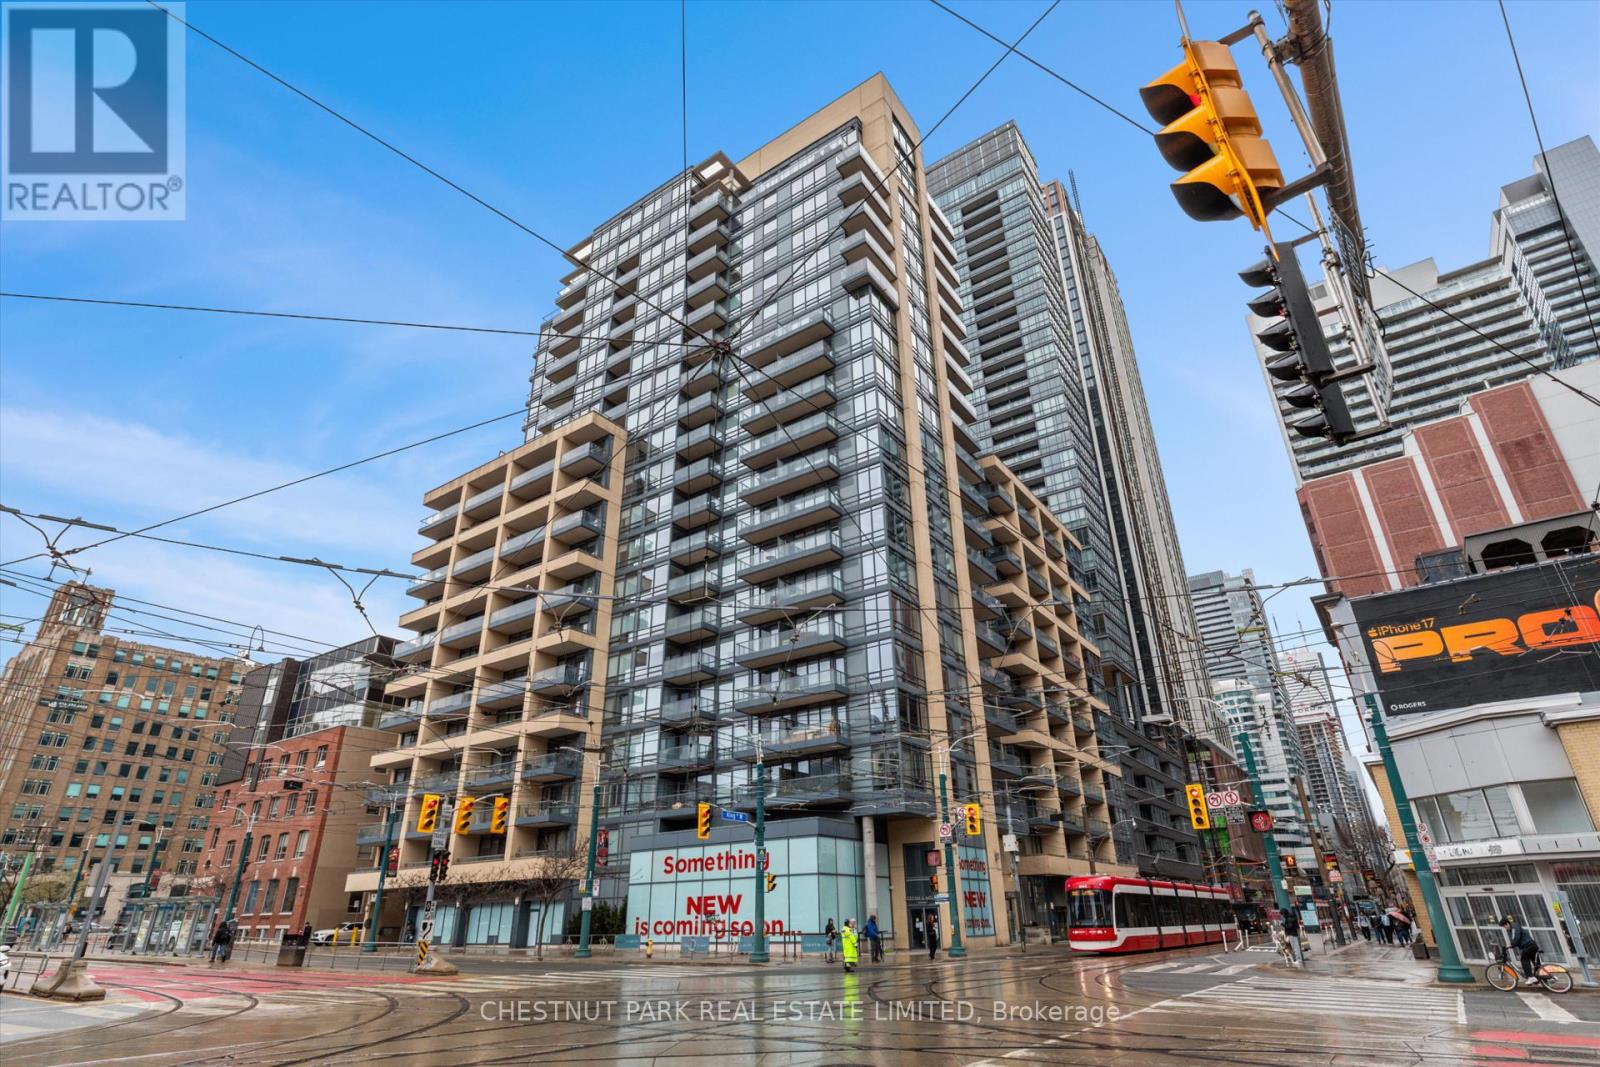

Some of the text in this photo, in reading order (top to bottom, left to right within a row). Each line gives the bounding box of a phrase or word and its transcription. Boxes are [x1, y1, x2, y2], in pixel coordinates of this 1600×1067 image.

[1378, 617, 1435, 636] iPhone 17
[1371, 605, 1600, 673] PRO
[1399, 700, 1427, 710] ROGERS
[1258, 704, 1272, 741] HYATT
[686, 894, 743, 915] NEW
[964, 891, 986, 908] NEW
[635, 916, 648, 936] is
[653, 915, 726, 939] coming
